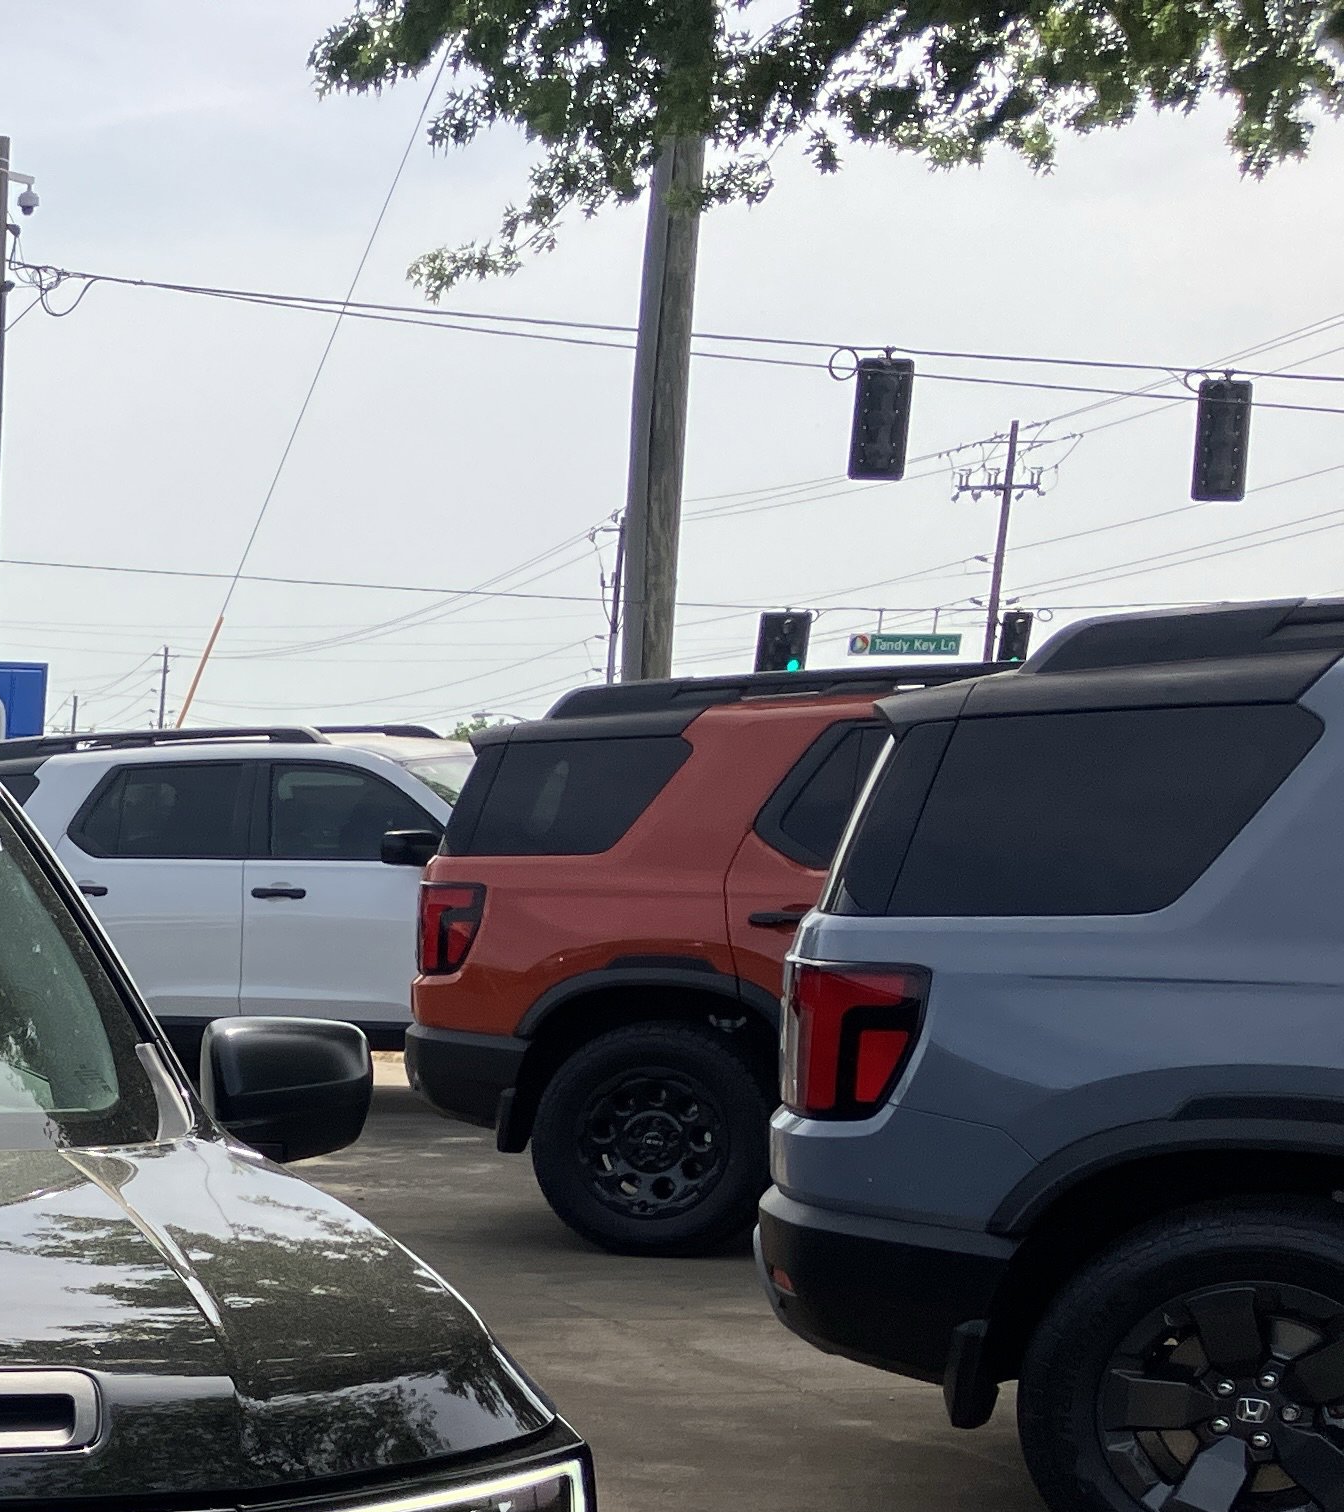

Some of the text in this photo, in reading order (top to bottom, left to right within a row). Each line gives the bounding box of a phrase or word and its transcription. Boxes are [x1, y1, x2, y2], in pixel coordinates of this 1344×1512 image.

[874, 638, 956, 653] Tandy Key Ln
